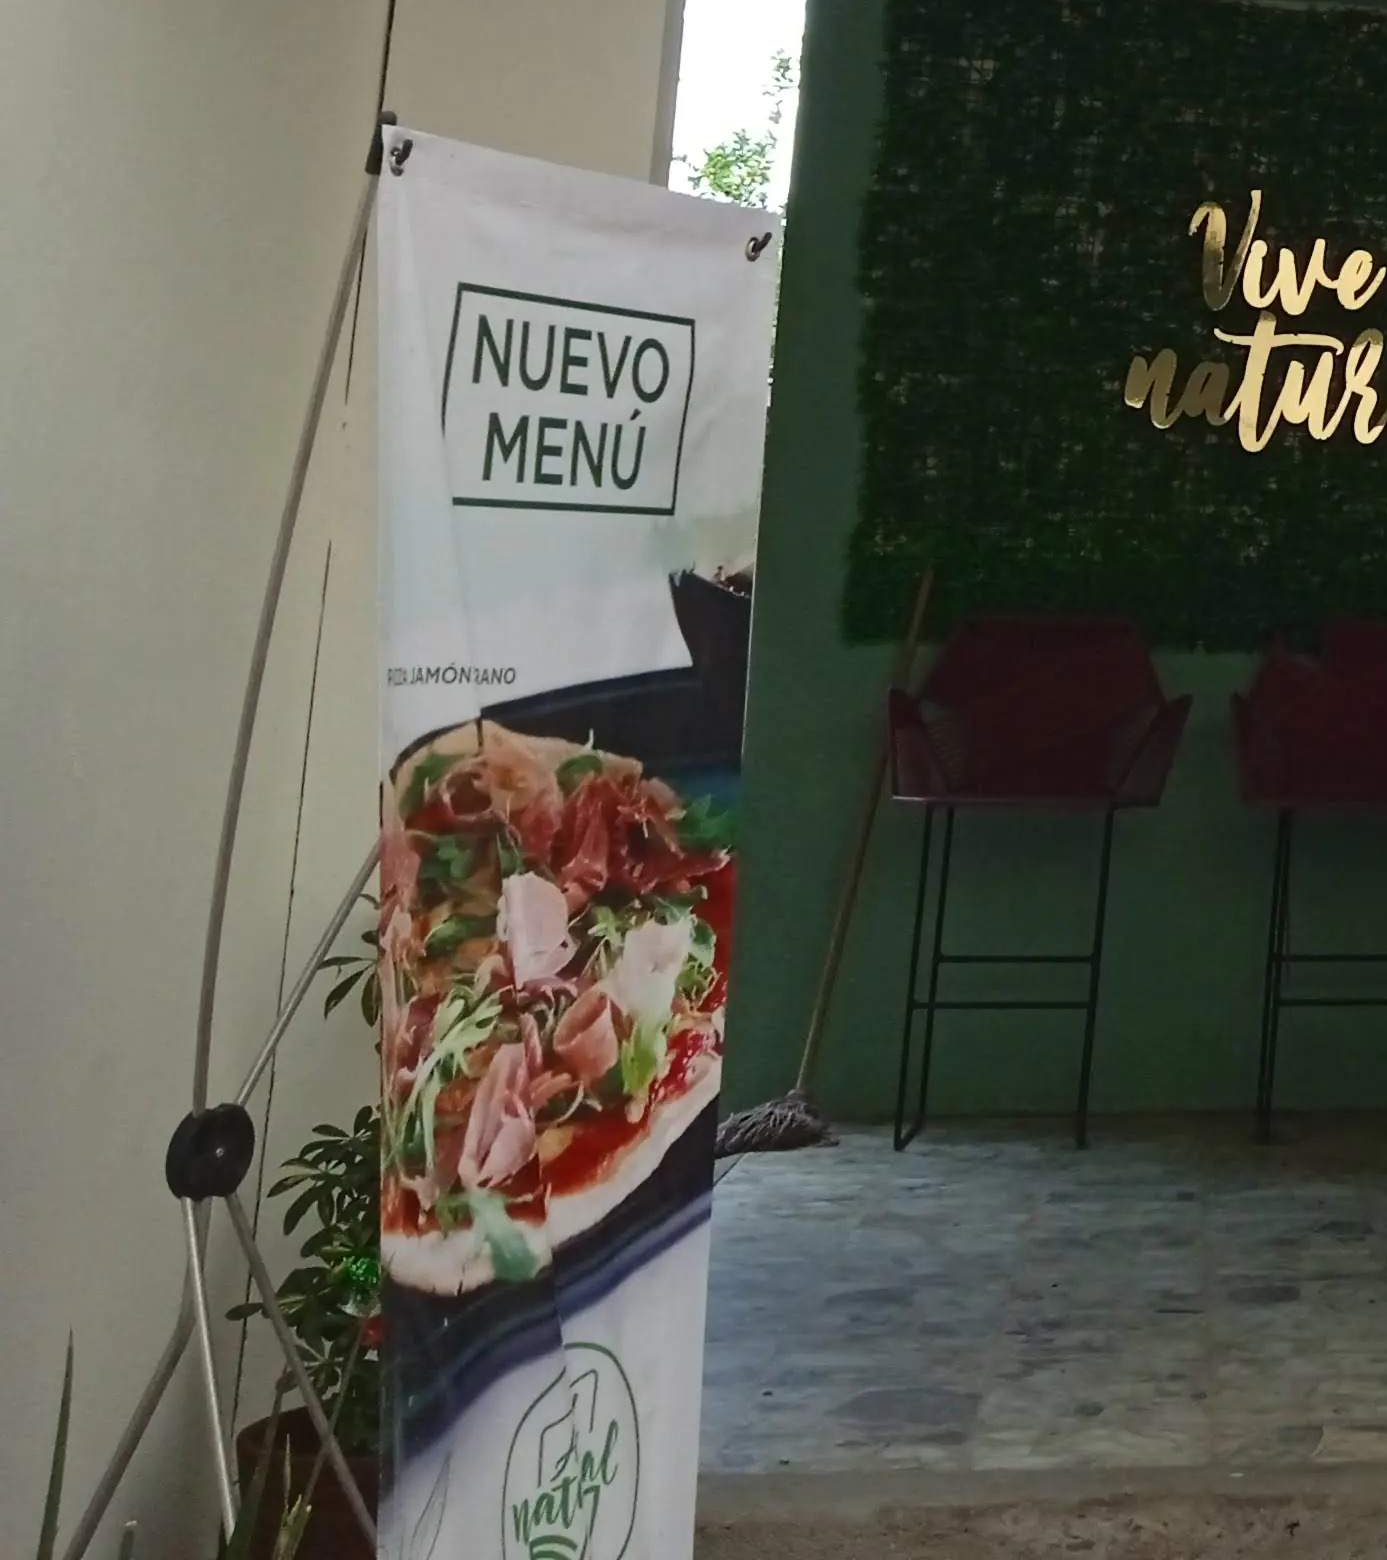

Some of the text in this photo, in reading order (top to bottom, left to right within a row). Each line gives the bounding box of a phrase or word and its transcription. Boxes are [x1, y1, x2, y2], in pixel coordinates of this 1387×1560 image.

[1188, 189, 1387, 316] Vive
[472, 314, 669, 403] NUEVO
[482, 408, 646, 490] MENÚ
[409, 662, 472, 685] JAMÓN
